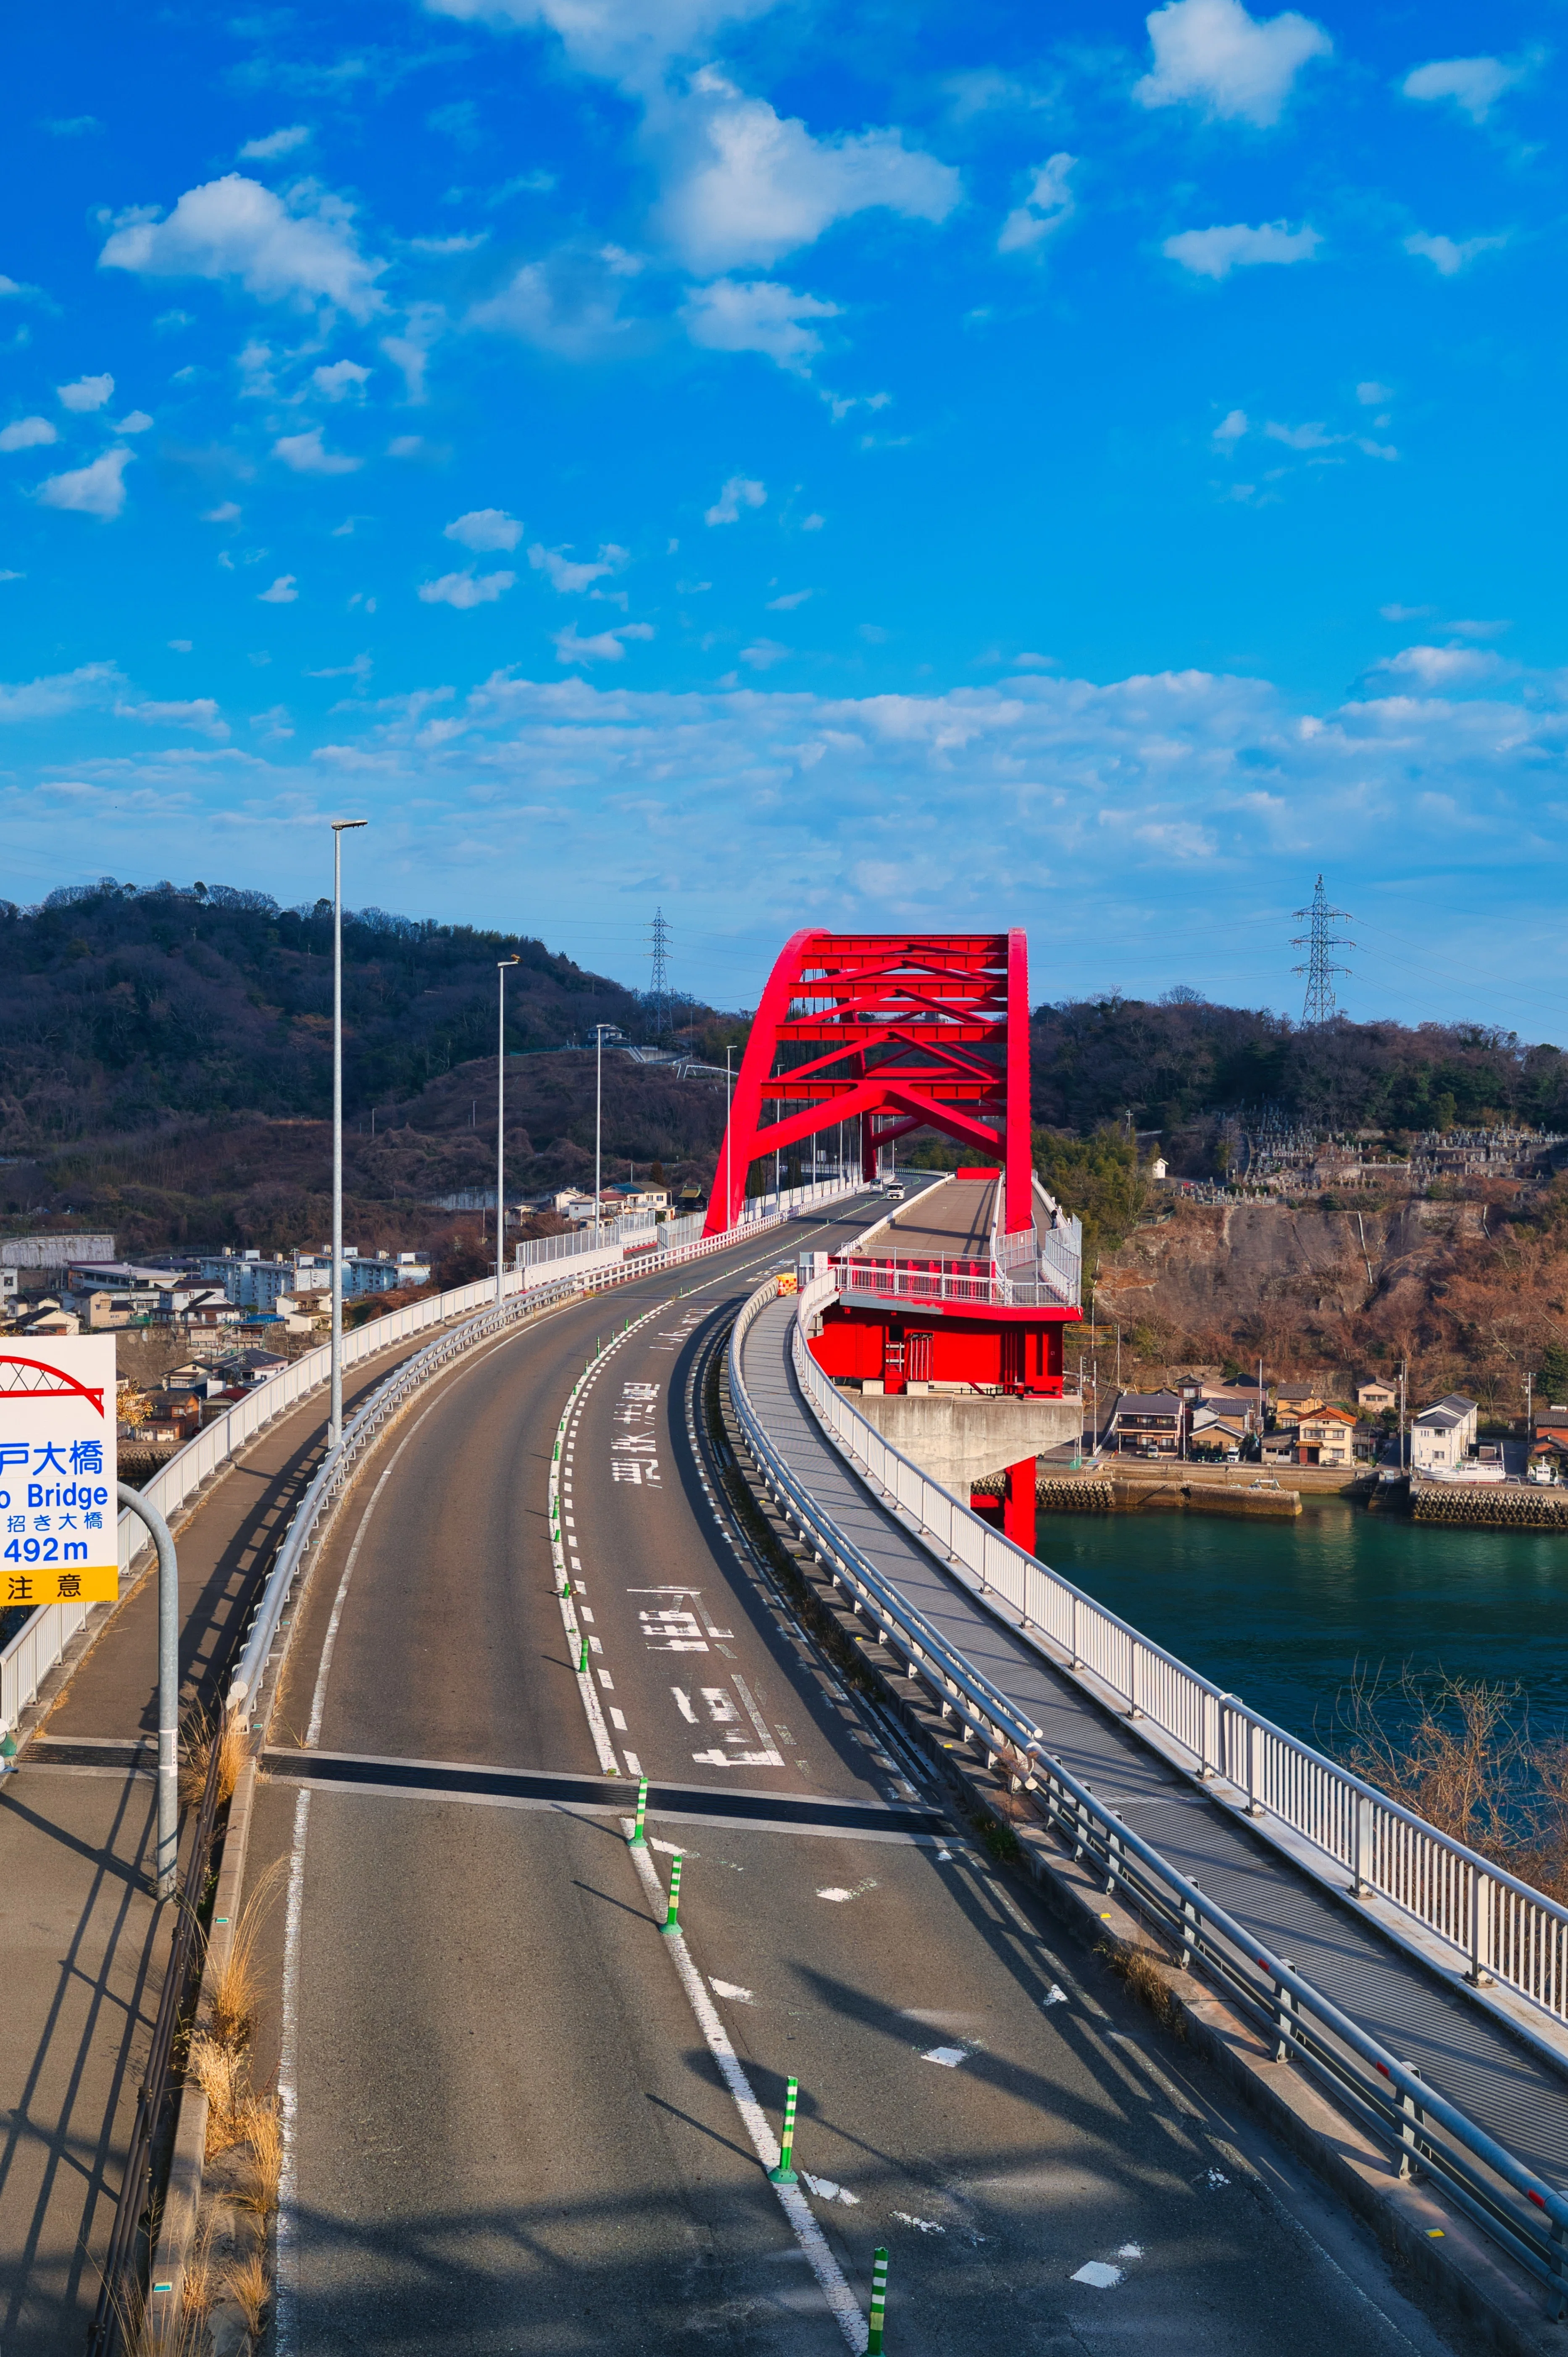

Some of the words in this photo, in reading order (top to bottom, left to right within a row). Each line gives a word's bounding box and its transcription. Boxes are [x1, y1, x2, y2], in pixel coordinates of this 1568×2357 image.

[0, 1440, 103, 1476] 戸大橋
[28, 1482, 108, 1510] Bridge
[4, 1537, 87, 1562] 492m
